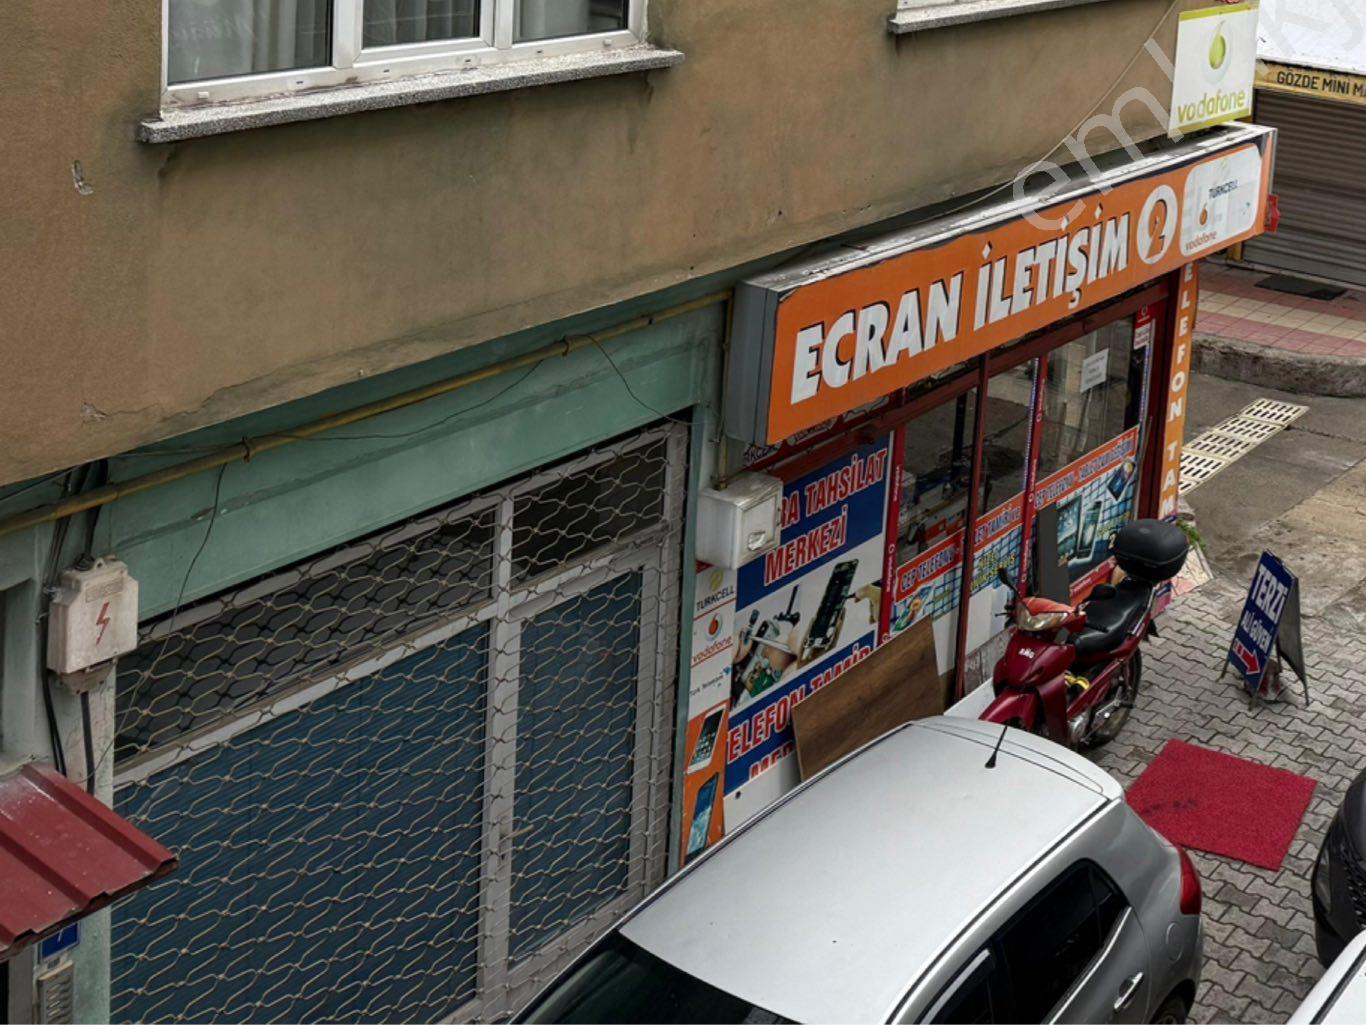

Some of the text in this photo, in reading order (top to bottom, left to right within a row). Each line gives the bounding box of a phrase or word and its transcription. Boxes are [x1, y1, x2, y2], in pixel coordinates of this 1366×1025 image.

[1177, 89, 1245, 122] vodafone
[1277, 68, 1318, 90] GÖZDE
[1322, 75, 1349, 95] MİNİ
[791, 272, 963, 405] ECRAN
[973, 203, 1131, 310] İLETİŞİM
[805, 448, 888, 517] TAHSİLAT
[764, 504, 848, 587] MERKEZİ
[696, 585, 735, 611] TURKCELL
[1251, 563, 1288, 624] TERZİ
[693, 636, 732, 663] vodafone
[727, 684, 806, 765] ELEFON
